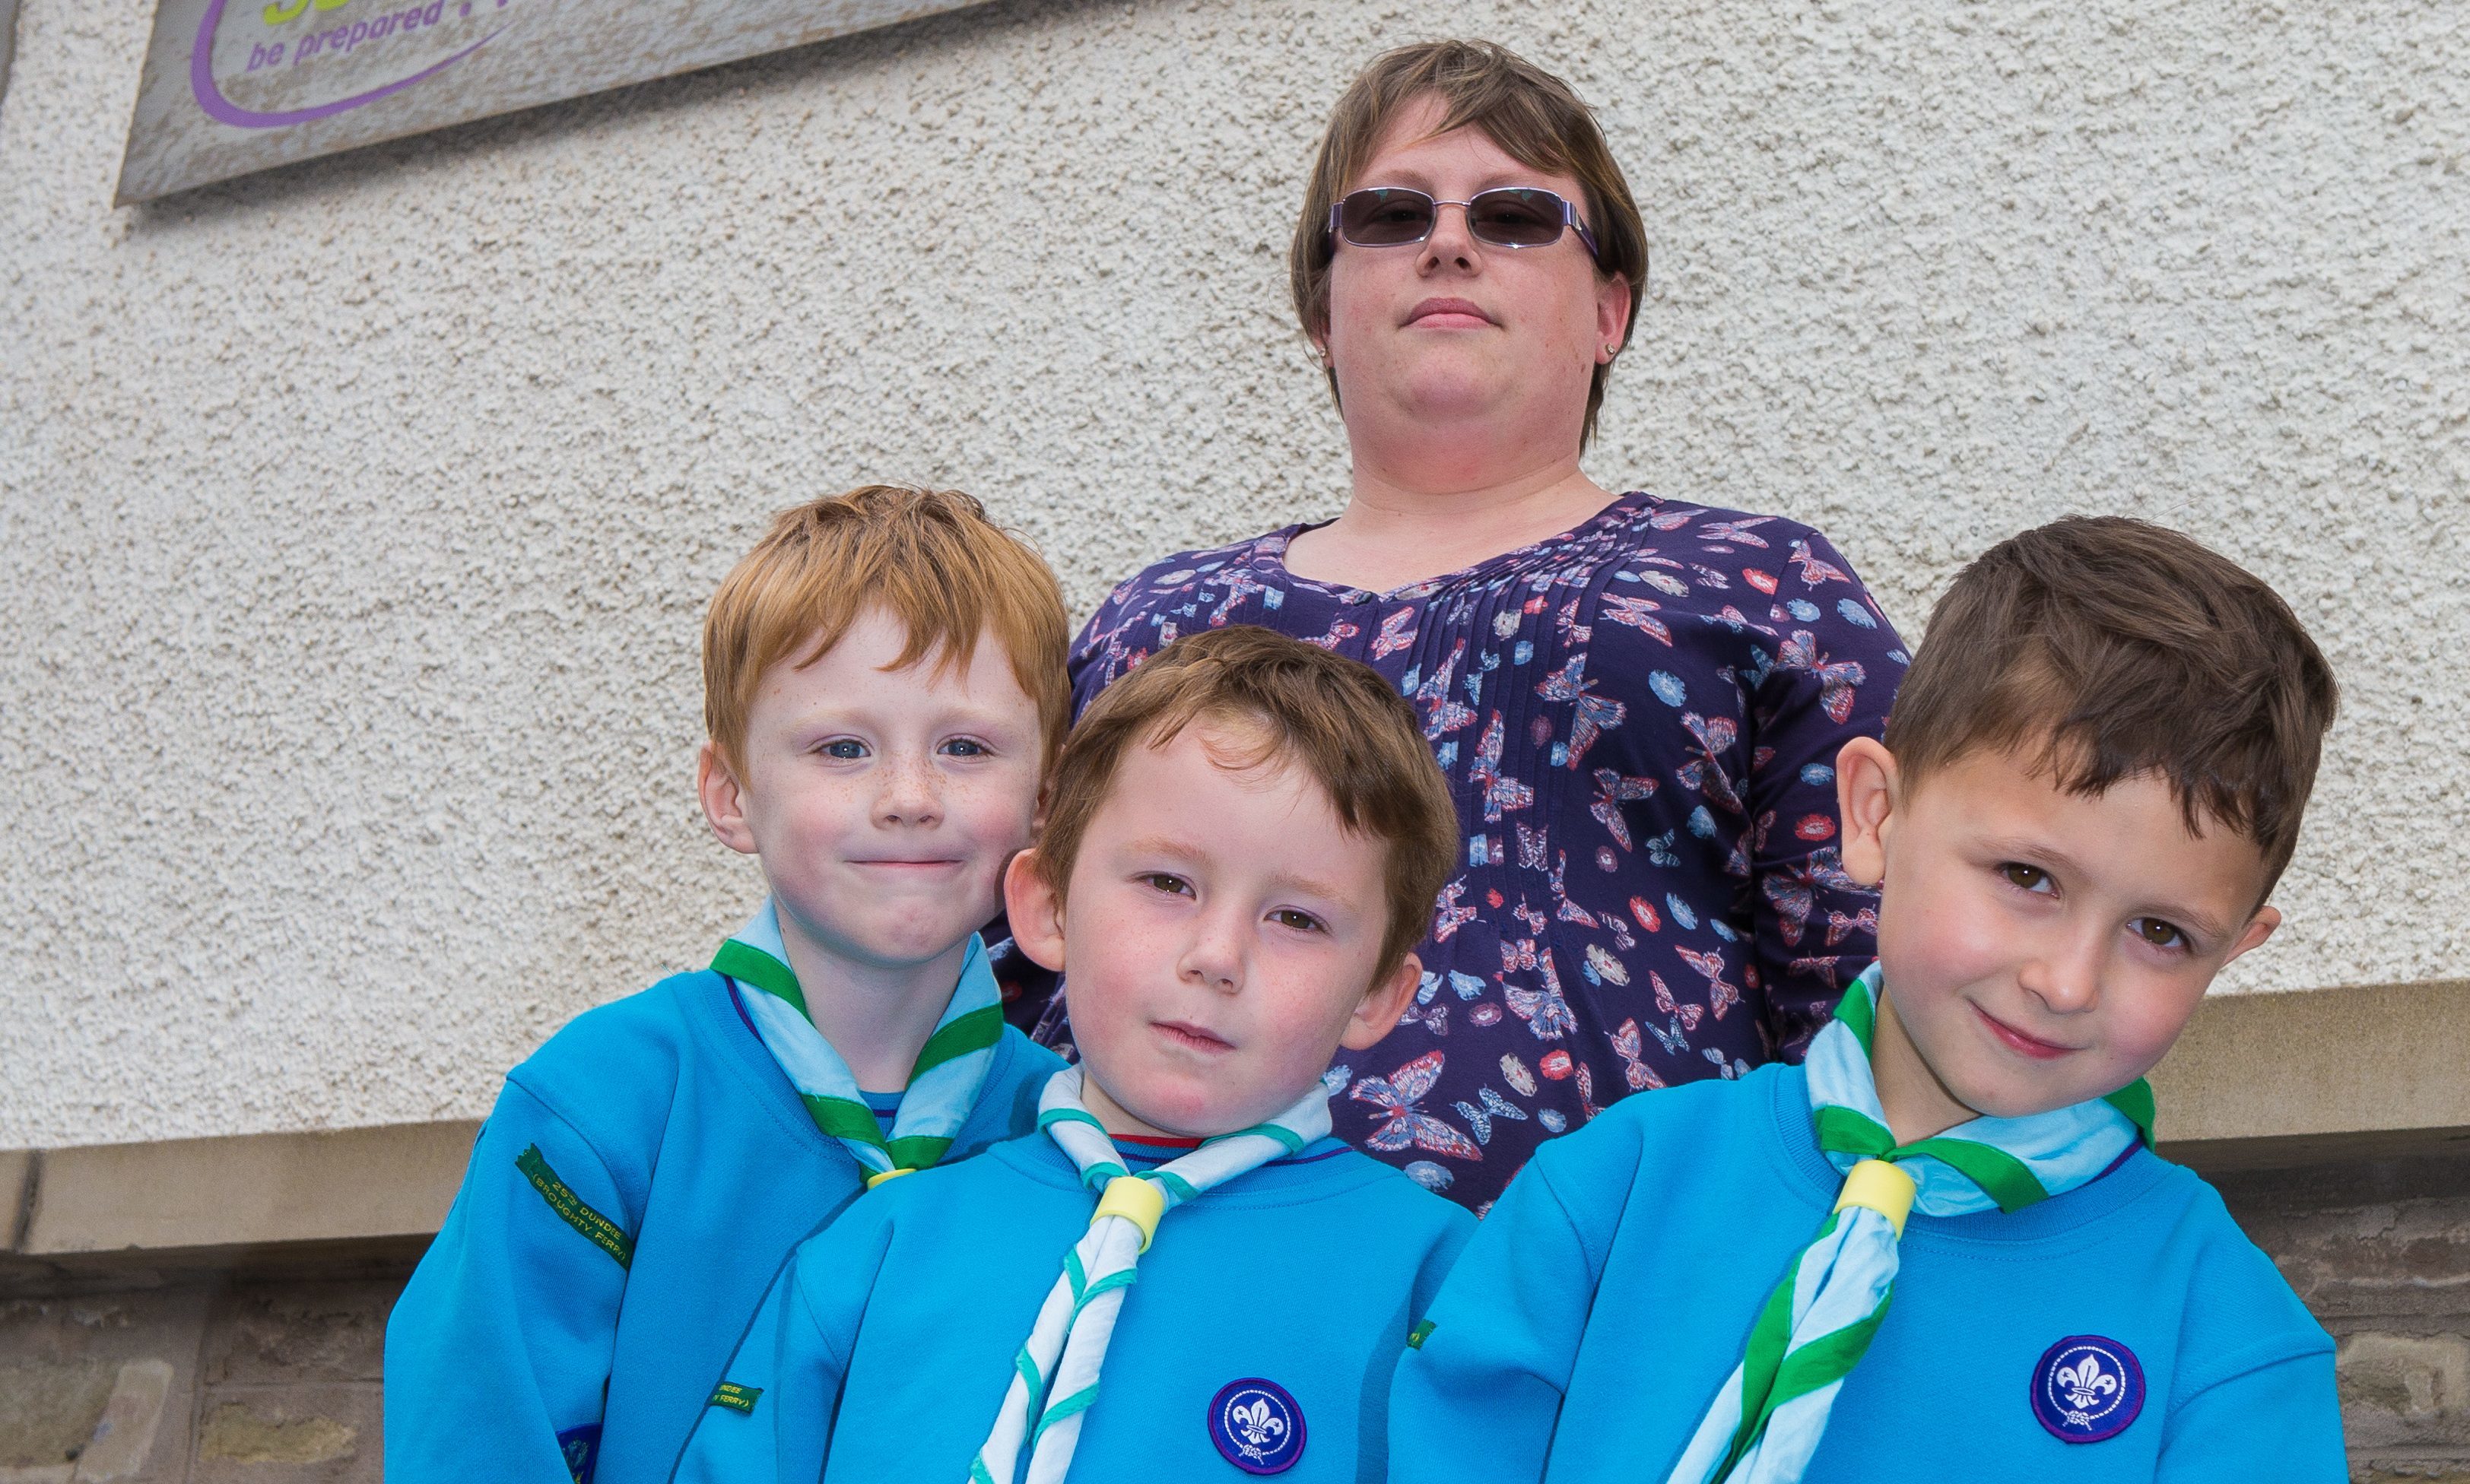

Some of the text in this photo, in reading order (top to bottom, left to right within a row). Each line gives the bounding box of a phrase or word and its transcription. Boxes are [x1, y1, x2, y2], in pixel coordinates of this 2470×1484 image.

[246, 41, 284, 73] be
[293, 0, 443, 67] prepared
[532, 1173, 592, 1232] (BROUGHTY
[579, 1207, 622, 1240] DUNDEE
